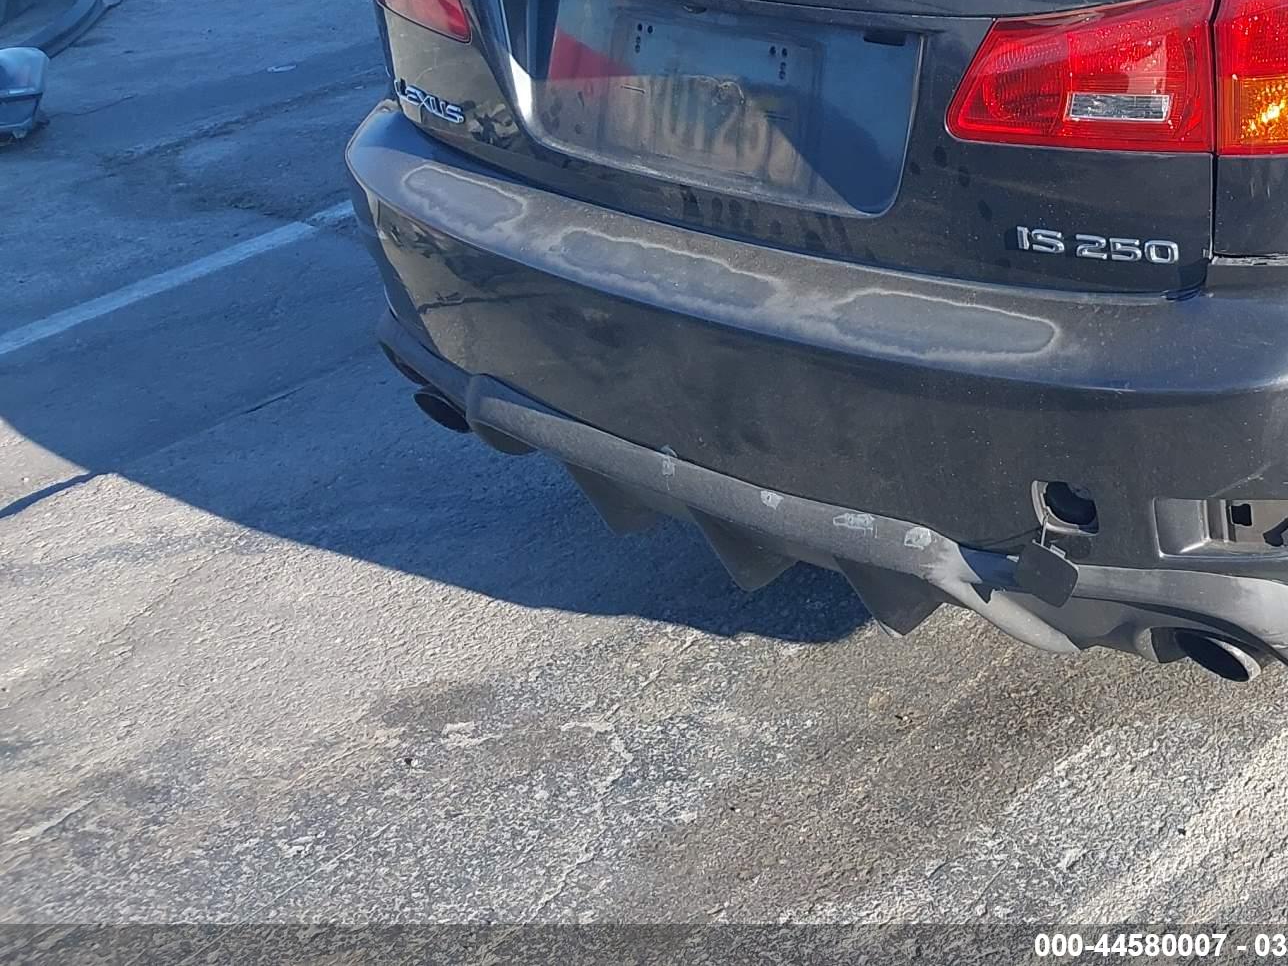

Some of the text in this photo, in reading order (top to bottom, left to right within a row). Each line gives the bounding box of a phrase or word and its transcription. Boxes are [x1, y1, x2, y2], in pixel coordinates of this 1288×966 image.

[393, 78, 465, 124] LEXUS
[1016, 225, 1179, 264] IS 250
